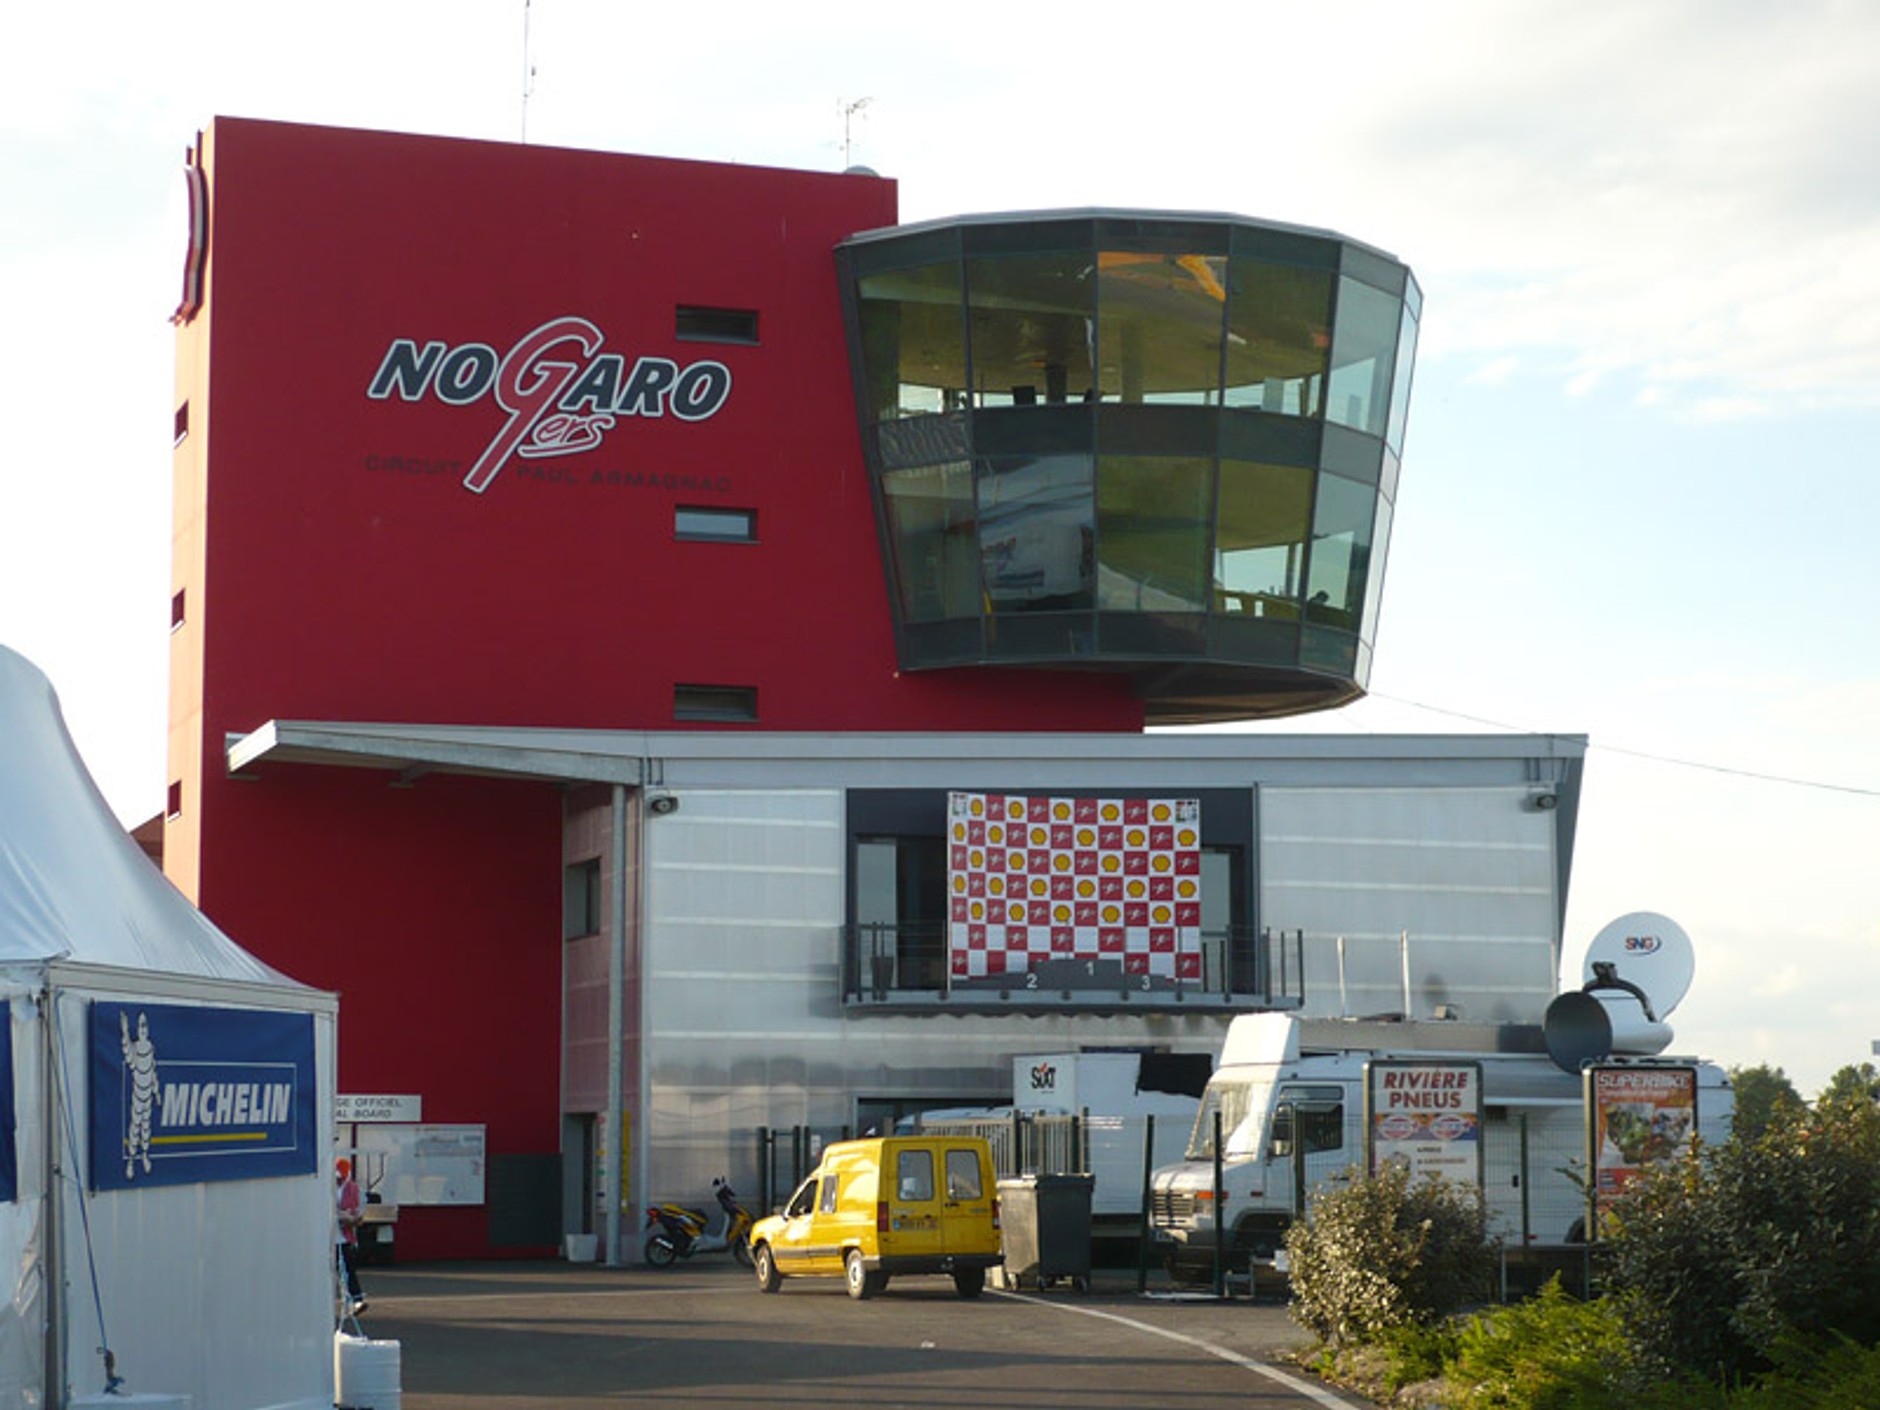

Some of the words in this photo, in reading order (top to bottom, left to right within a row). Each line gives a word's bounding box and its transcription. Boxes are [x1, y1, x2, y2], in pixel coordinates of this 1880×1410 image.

[366, 315, 732, 493] NOGARO
[364, 453, 462, 476] CIRCUIT
[516, 465, 579, 483] PAUL
[590, 469, 733, 493] ARMAGNAC
[1086, 961, 1094, 976] 1
[1027, 974, 1038, 988] 2
[1141, 975, 1150, 989] 3
[161, 1082, 291, 1127] MICHELIN
[355, 1097, 402, 1108] OFFICIEL
[1389, 1091, 1462, 1108] PNEUS
[354, 1109, 391, 1119] BOARD
